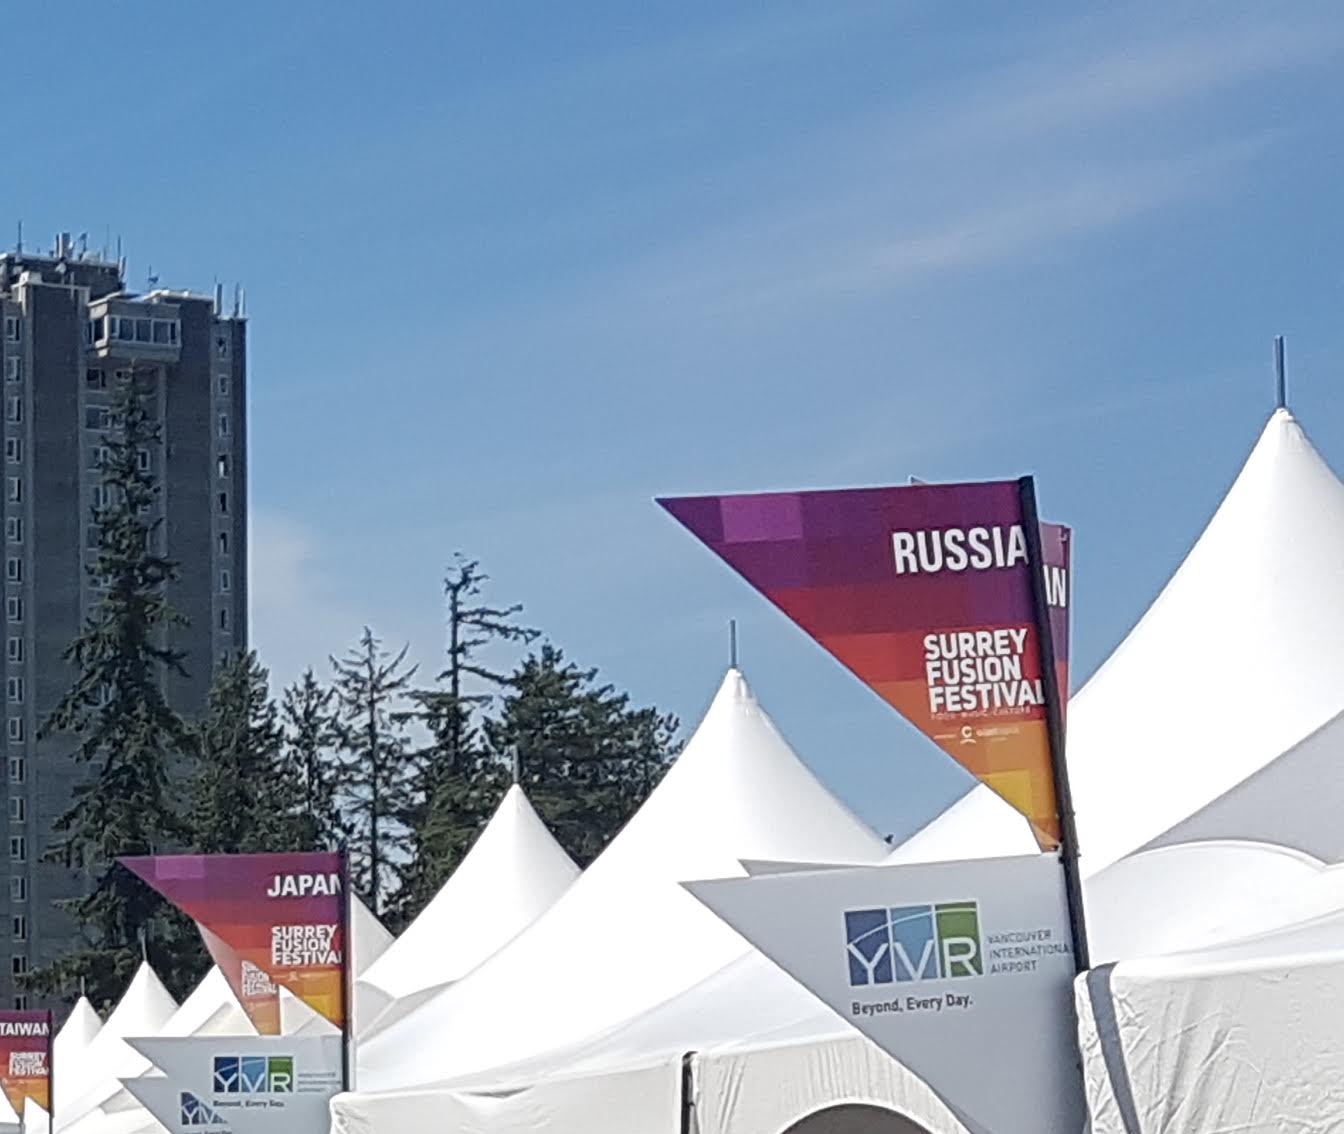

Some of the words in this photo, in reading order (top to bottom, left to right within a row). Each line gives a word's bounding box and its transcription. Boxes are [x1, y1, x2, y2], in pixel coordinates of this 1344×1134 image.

[892, 525, 1030, 574] RUSSIA
[923, 628, 1028, 661] SURREY
[925, 655, 1022, 687] FUSION
[271, 924, 338, 939] SURREY
[987, 929, 1052, 944] VANCOUVER
[271, 938, 331, 952] FUSION
[989, 943, 1070, 960] INTERNATIONA
[847, 935, 984, 985] YVR
[990, 959, 1037, 974] AIRPORT
[906, 997, 944, 1012] Every
[945, 994, 973, 1009] Day.
[213, 1070, 293, 1093] YVR
